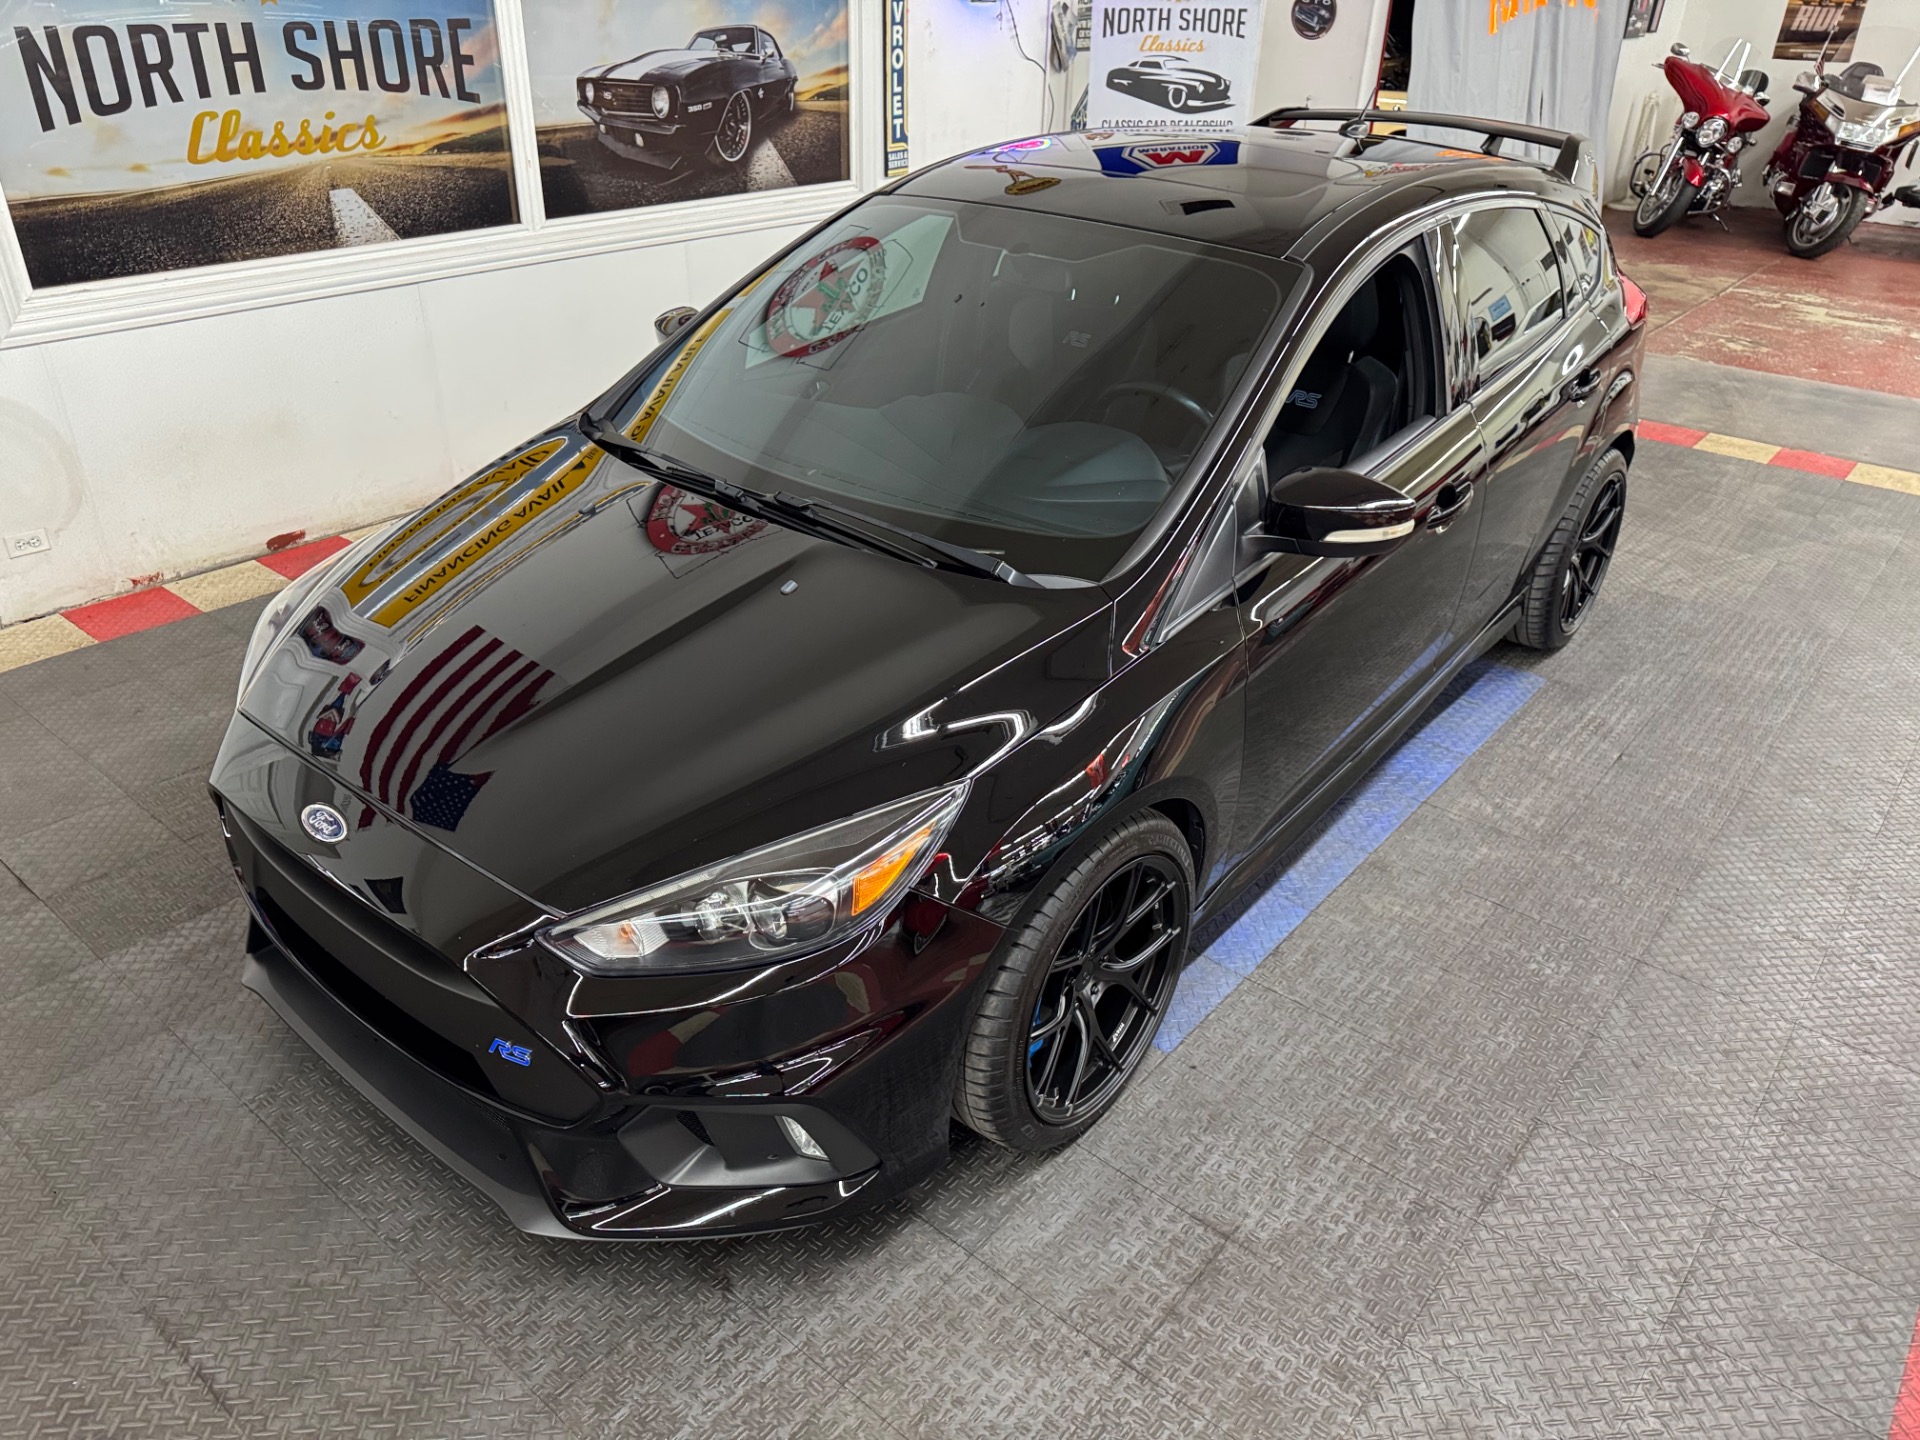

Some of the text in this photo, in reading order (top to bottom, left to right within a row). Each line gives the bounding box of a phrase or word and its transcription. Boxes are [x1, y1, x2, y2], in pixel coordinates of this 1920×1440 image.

[1102, 7, 1172, 39] NORTH
[1178, 8, 1248, 39] SHORE
[1138, 34, 1206, 53] Classics
[14, 18, 482, 132] NORTH SHORE
[186, 108, 387, 166] Classics
[1285, 389, 1322, 409] RS
[309, 810, 337, 835] Ford
[488, 1037, 533, 1067] RS
